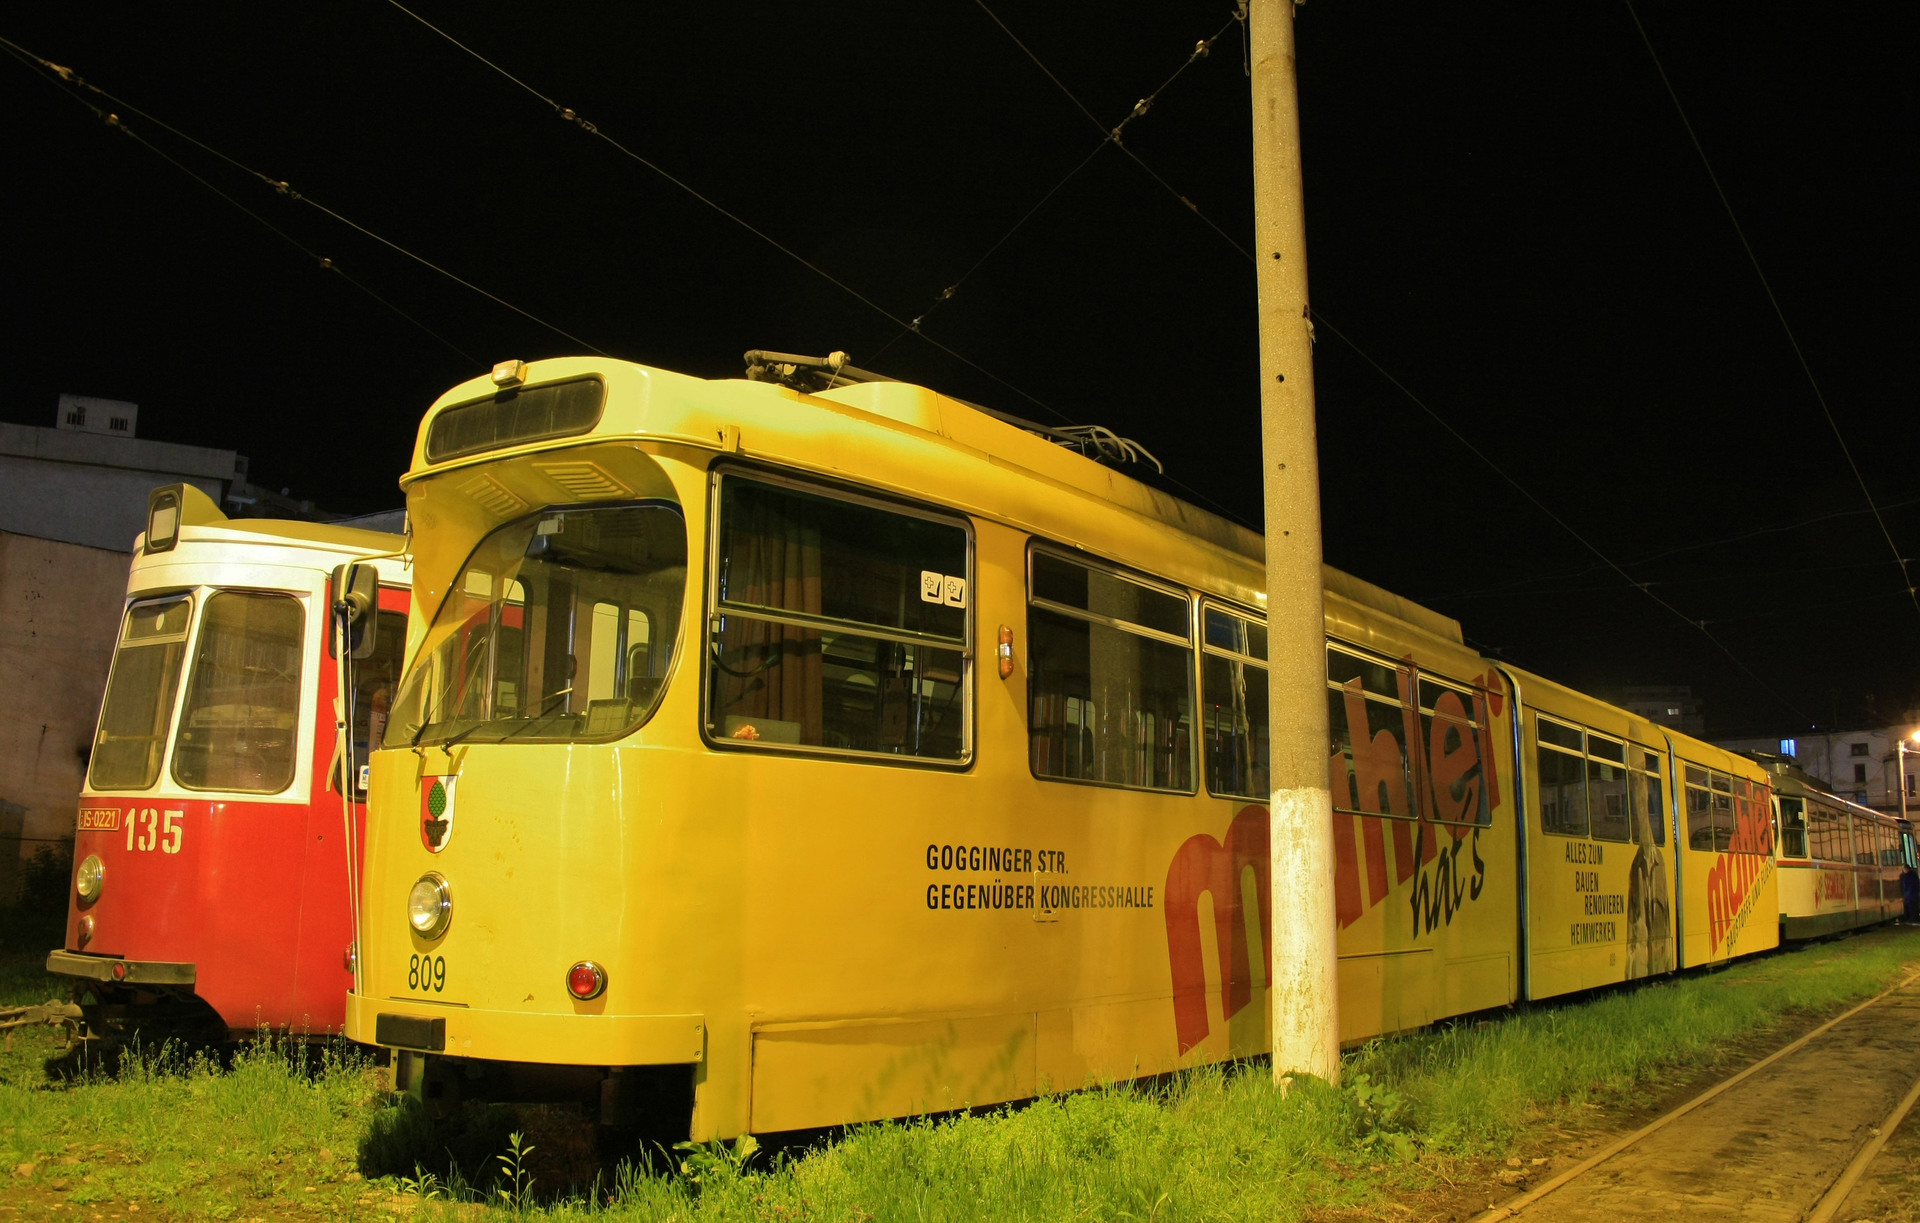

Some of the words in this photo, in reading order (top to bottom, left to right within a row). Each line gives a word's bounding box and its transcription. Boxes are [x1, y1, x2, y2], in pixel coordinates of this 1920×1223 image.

[125, 808, 184, 854] 135
[926, 844, 1032, 873] GOGGINGER
[1037, 850, 1069, 875] STR.
[1565, 841, 1587, 864] ALLES
[1588, 844, 1603, 865] ZUM
[926, 879, 1034, 909] GEGENÜBER
[1041, 885, 1154, 909] KONGRESSHALLE
[1575, 871, 1599, 892] BAUEN
[1584, 895, 1624, 915] RENOVIEREN
[1570, 921, 1616, 945] HEIMWERKEN
[408, 953, 446, 993] 809
